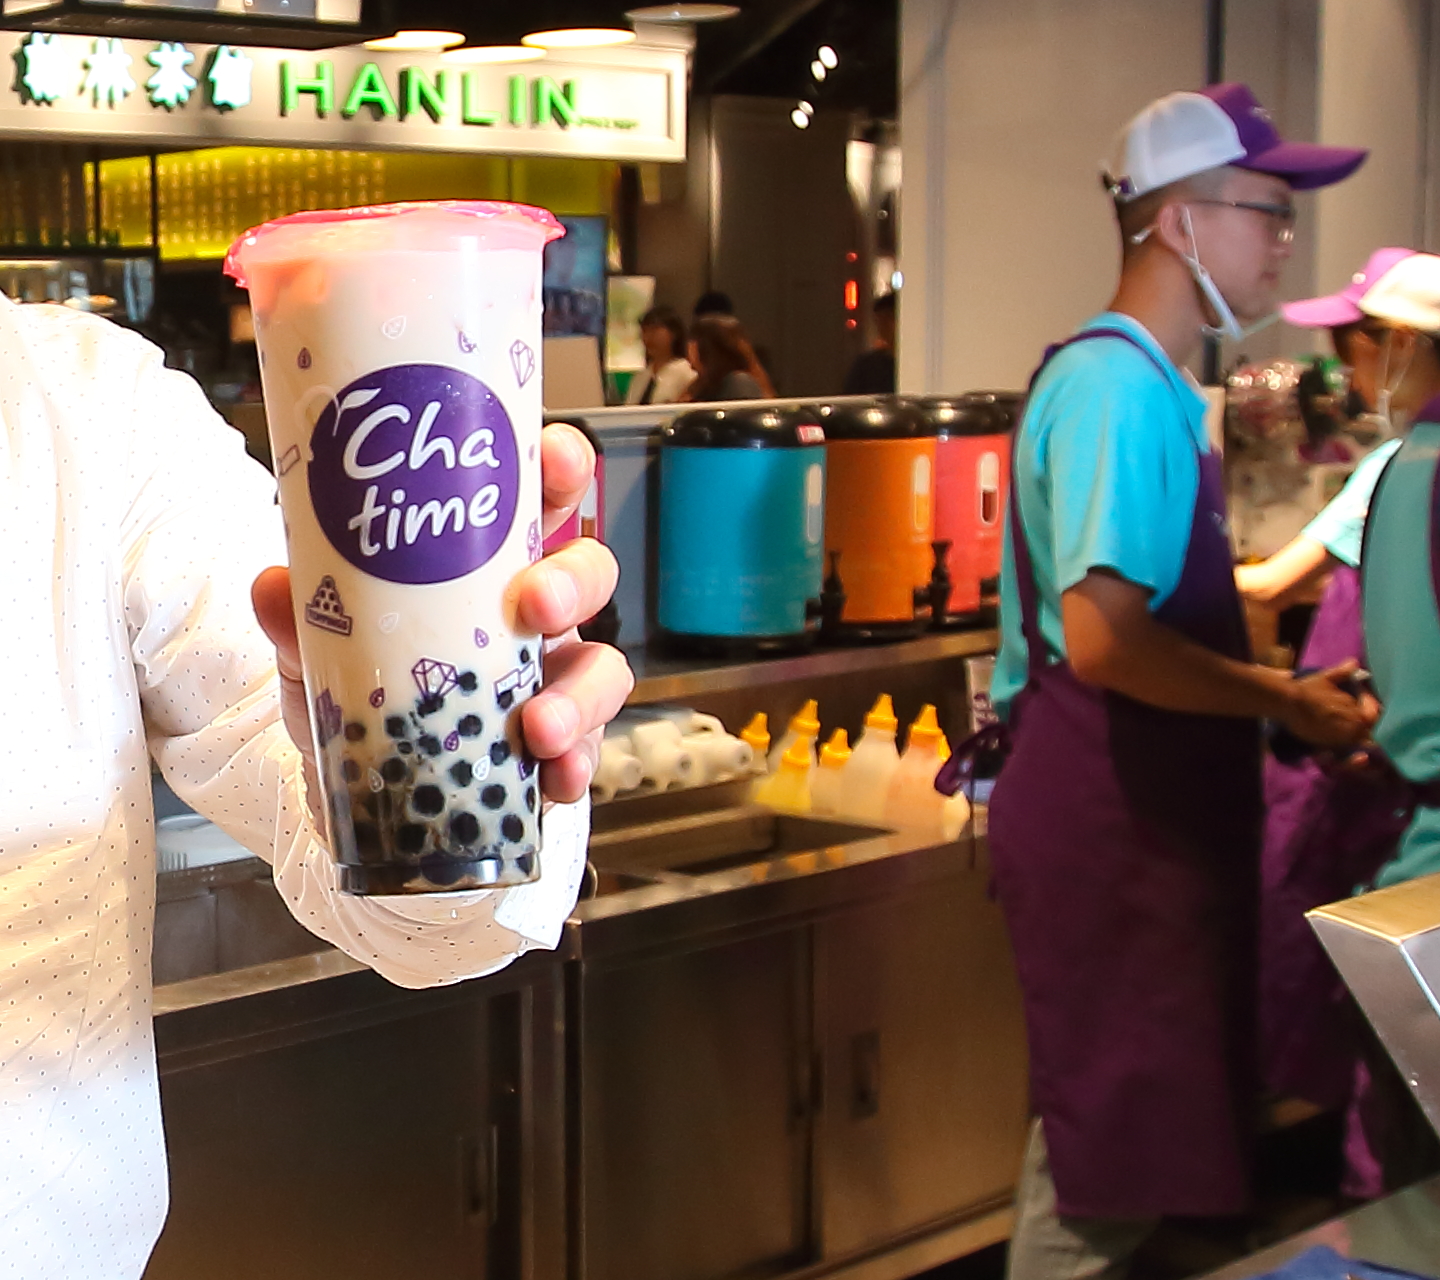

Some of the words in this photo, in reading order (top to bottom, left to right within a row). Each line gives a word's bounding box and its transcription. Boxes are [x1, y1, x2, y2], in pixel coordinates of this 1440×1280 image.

[280, 59, 578, 127] HANLIN
[342, 400, 502, 481] Cha
[347, 483, 501, 557] time
